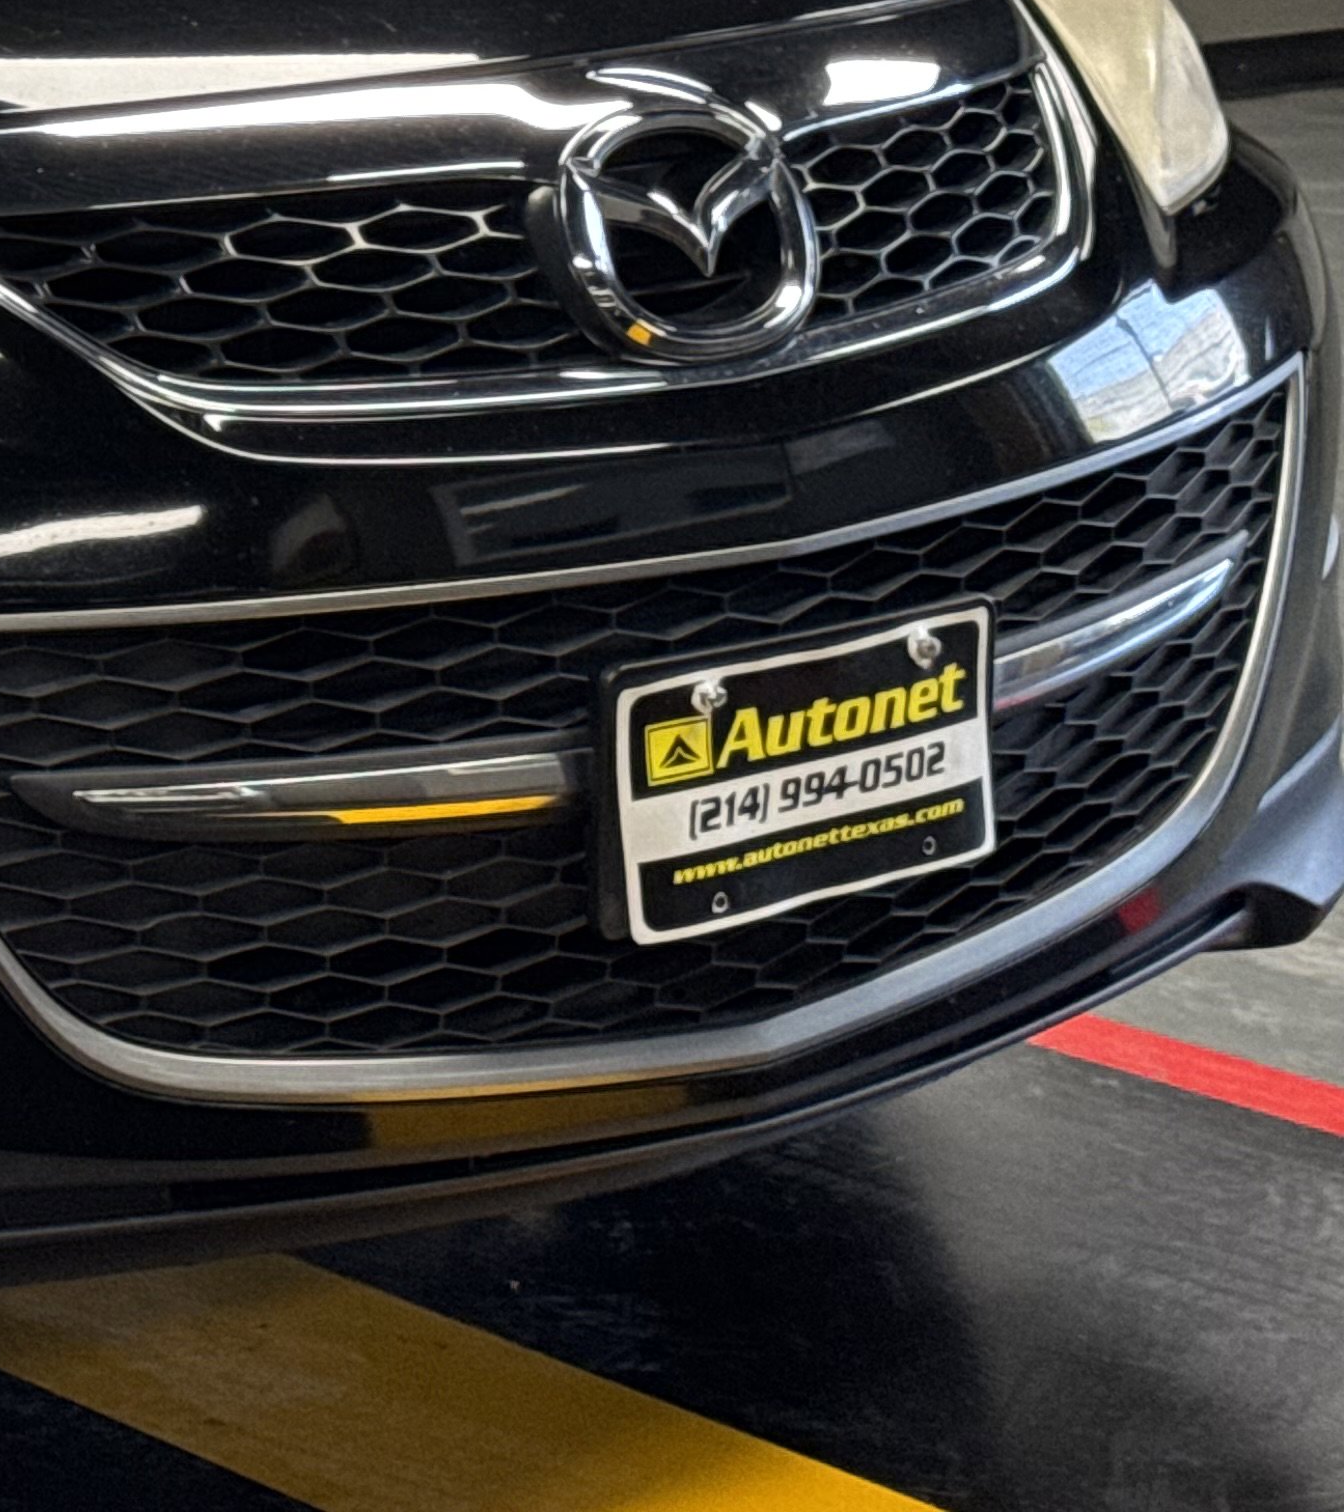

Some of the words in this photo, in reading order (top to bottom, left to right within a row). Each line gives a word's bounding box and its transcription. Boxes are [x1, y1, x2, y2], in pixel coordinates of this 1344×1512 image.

[716, 662, 966, 769] Autonet
[689, 783, 770, 840] (214)
[778, 741, 946, 813] 994-0502
[673, 798, 965, 885] www.autonettexas.com
